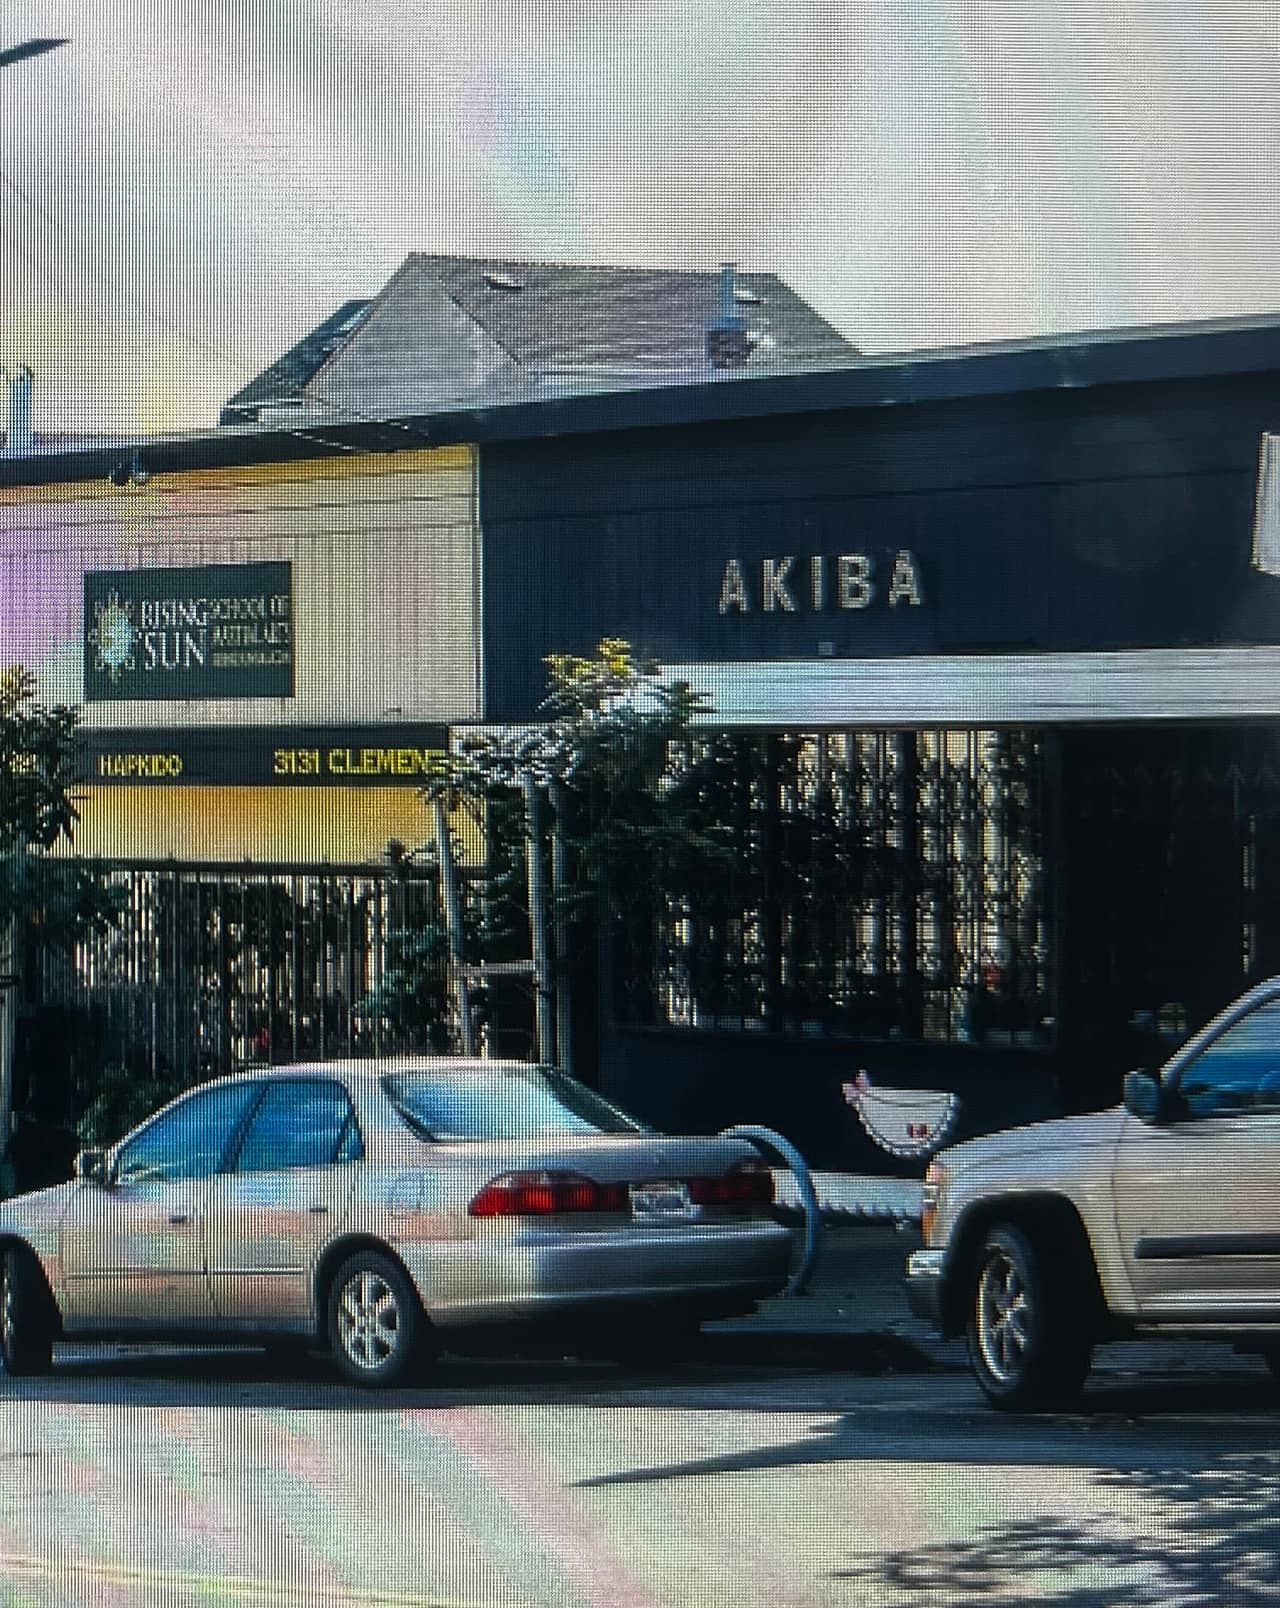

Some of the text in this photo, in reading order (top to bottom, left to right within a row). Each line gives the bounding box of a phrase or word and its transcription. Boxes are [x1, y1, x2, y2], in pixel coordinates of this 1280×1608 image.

[719, 549, 921, 614] AKIBA
[141, 597, 208, 629] RISING
[144, 629, 208, 670] SUN
[99, 753, 184, 777] HAPKIDO
[273, 748, 320, 775] 3131
